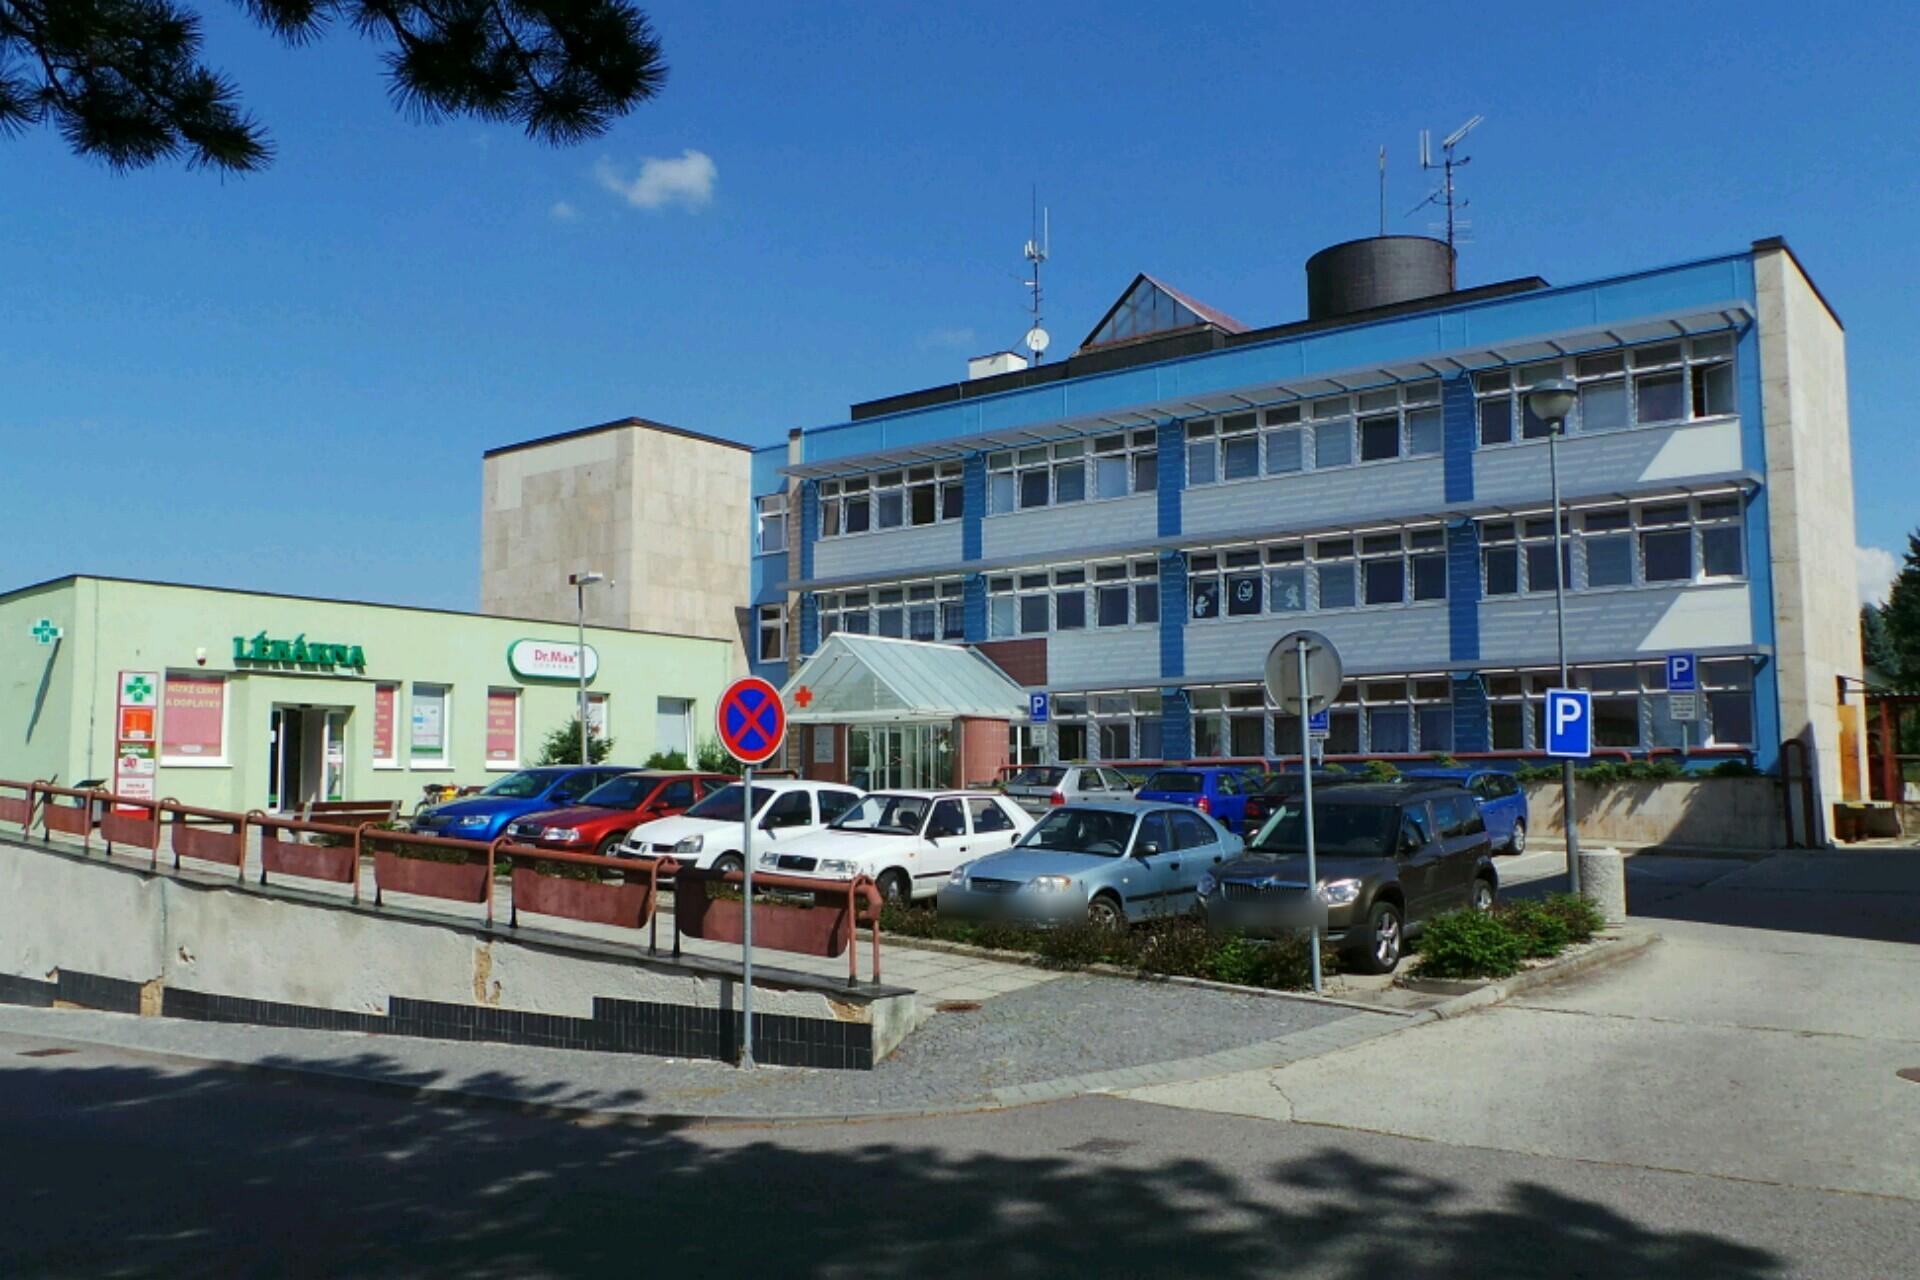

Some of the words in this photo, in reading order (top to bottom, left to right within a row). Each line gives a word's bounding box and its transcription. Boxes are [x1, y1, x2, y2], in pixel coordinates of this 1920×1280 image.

[233, 630, 367, 667] LÉKÁRNA
[1672, 657, 1690, 680] P
[1032, 696, 1045, 714] P
[1555, 697, 1582, 736] P
